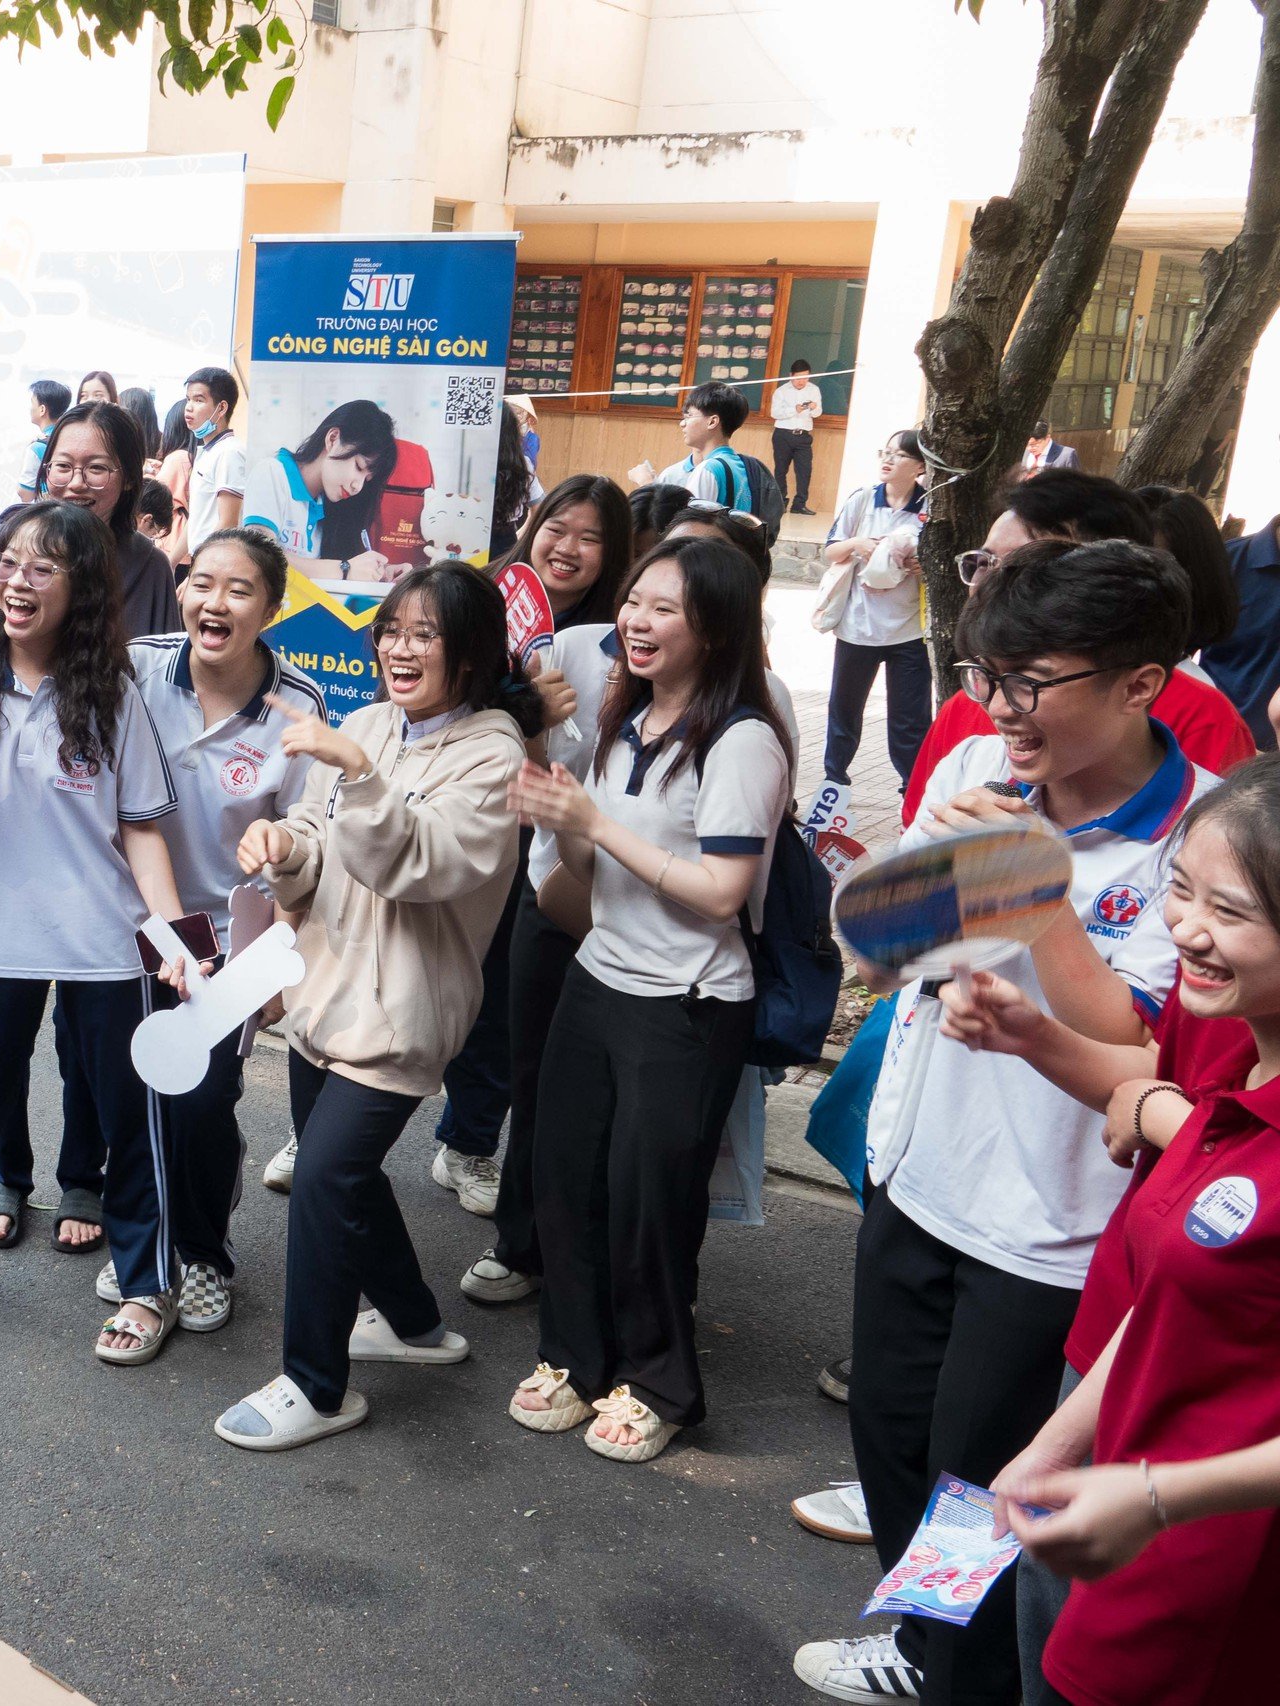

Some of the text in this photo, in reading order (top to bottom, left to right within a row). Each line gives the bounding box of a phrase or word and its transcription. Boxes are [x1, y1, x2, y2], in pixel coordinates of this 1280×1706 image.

[346, 275, 412, 309] STU
[315, 316, 439, 334] TRƯỜNG ĐẠI HỌC
[268, 333, 488, 359] CÔNG NGHỆ SÀI GÒN
[280, 530, 304, 548] ST
[278, 645, 318, 670] ÀNH
[322, 652, 364, 676] ĐÀO
[330, 684, 359, 700] thuật
[361, 691, 375, 700] cơ
[1085, 923, 1131, 941] HCMUT
[1190, 1223, 1210, 1240] 1959
[946, 1481, 966, 1496] 9
